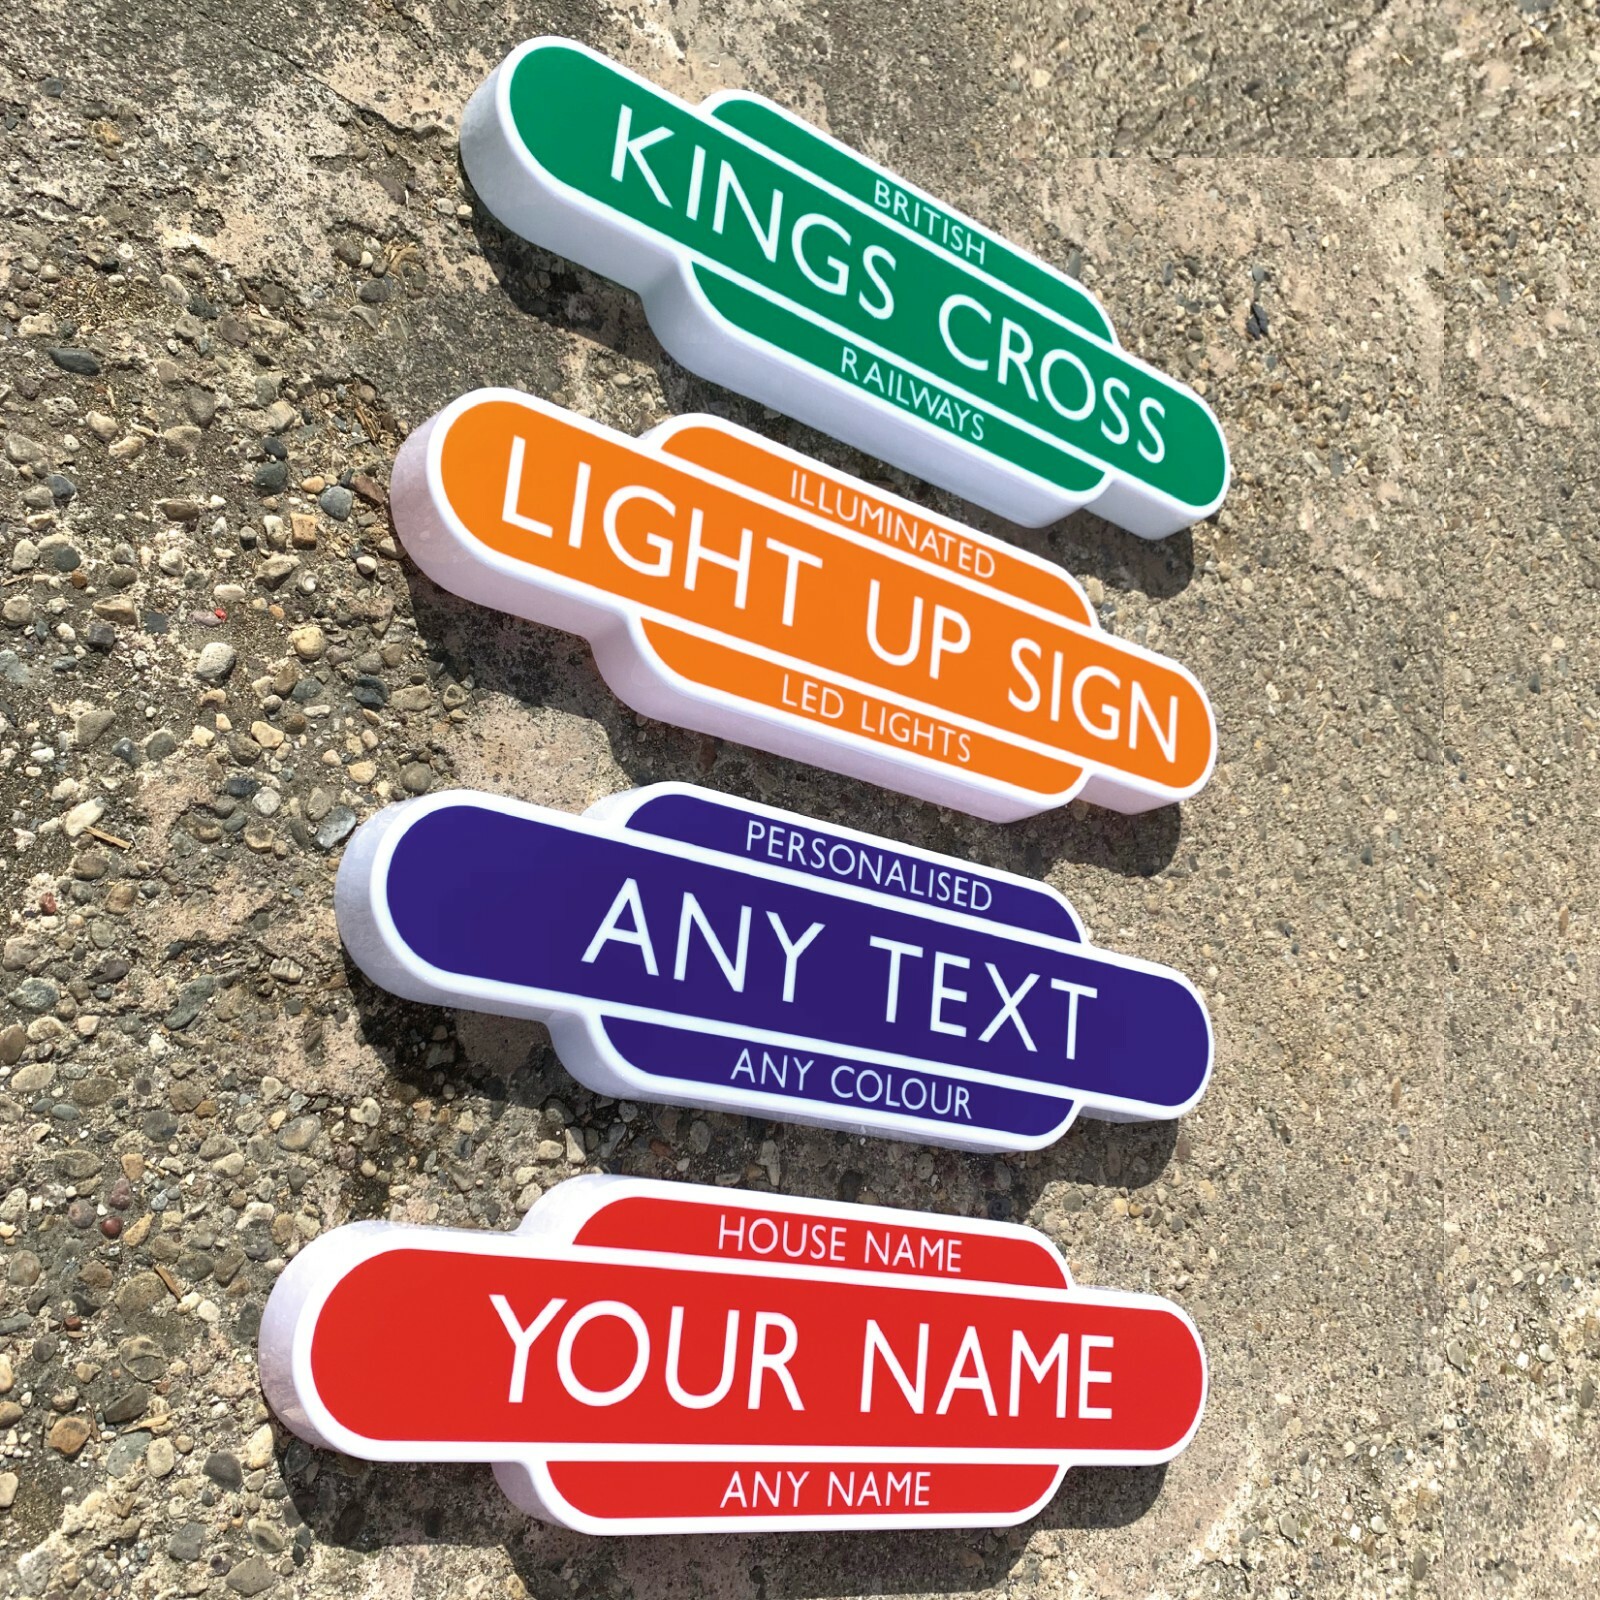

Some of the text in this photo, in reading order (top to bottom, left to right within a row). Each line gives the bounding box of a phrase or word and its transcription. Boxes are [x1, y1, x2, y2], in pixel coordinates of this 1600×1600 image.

[873, 179, 988, 264] BRITISH
[610, 104, 1166, 464] KINGS CROSS
[840, 346, 986, 443] RAILWAYS
[790, 469, 996, 579] ILLUMINATED
[501, 435, 1179, 764] LIGHT UP SIGN
[782, 673, 972, 764] LED LIGHTS
[745, 819, 993, 912] PERSONALISED
[581, 876, 1099, 1061] ANY TEXT
[730, 1047, 973, 1120] ANY COLOUR
[717, 1213, 963, 1274] HOUSE NAME
[488, 1293, 1115, 1421] YOUR NAME
[719, 1470, 932, 1509] ANY NAME
